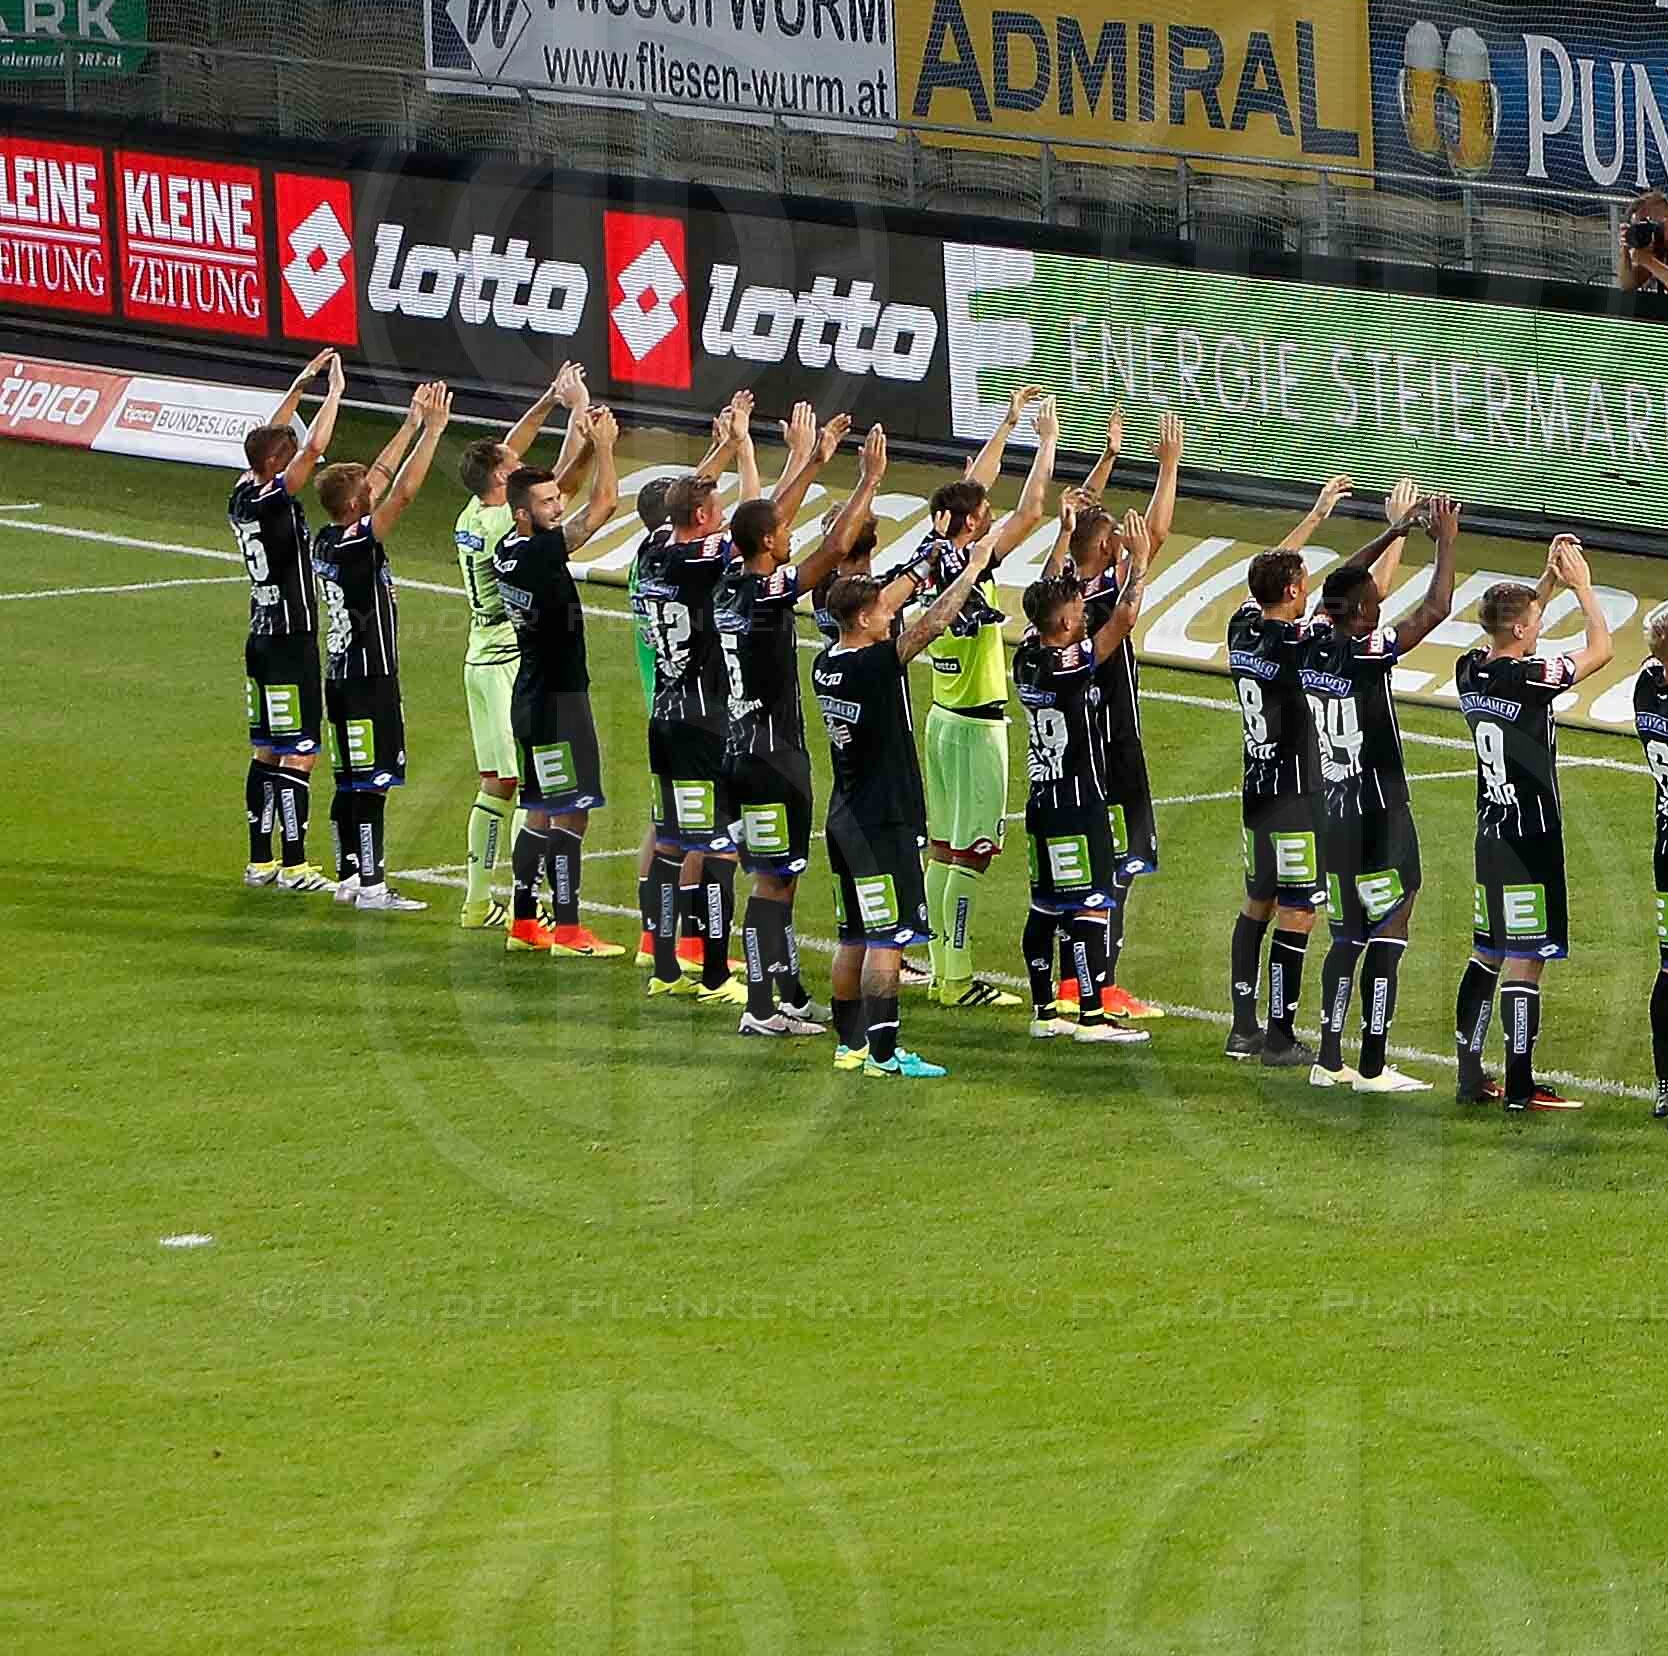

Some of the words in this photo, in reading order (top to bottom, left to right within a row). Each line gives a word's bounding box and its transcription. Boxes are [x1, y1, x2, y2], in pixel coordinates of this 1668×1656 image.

[543, 42, 889, 121] www.fliesen-wurm.at
[0, 153, 101, 230] LEINE
[123, 169, 257, 249] KLEINE
[0, 237, 105, 296] EITUNG
[127, 254, 261, 318] ZEITUNG
[367, 223, 589, 335] lotto
[700, 263, 938, 381] lotto
[0, 363, 100, 427] tipico
[1069, 318, 1303, 423] ENERGIE
[156, 409, 248, 438] BUNDESLIGA
[1239, 677, 1268, 743] 8
[1475, 721, 1506, 787] 9
